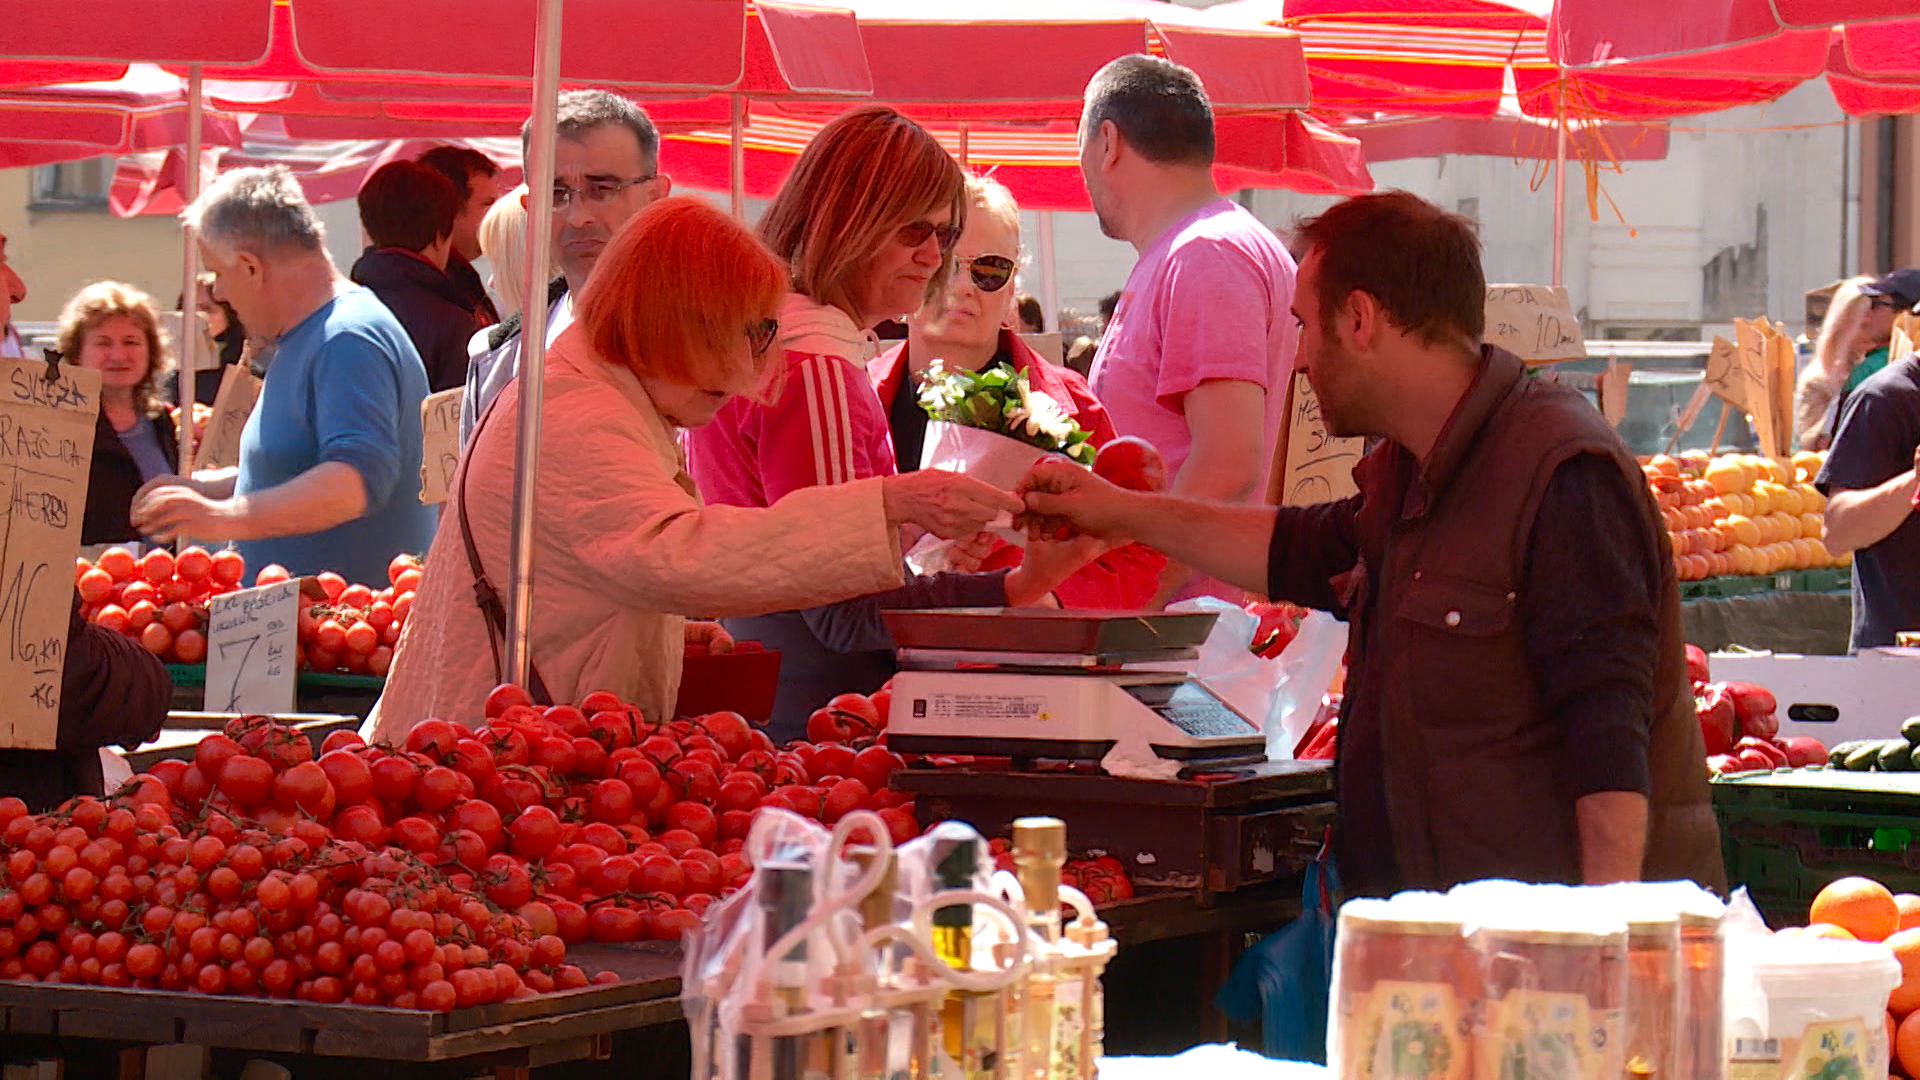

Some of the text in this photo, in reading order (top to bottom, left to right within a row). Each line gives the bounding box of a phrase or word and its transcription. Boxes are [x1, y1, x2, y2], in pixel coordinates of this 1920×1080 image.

[1536, 313, 1561, 353] 10
[0, 413, 87, 467] RAJČICA
[217, 633, 262, 712] 7
